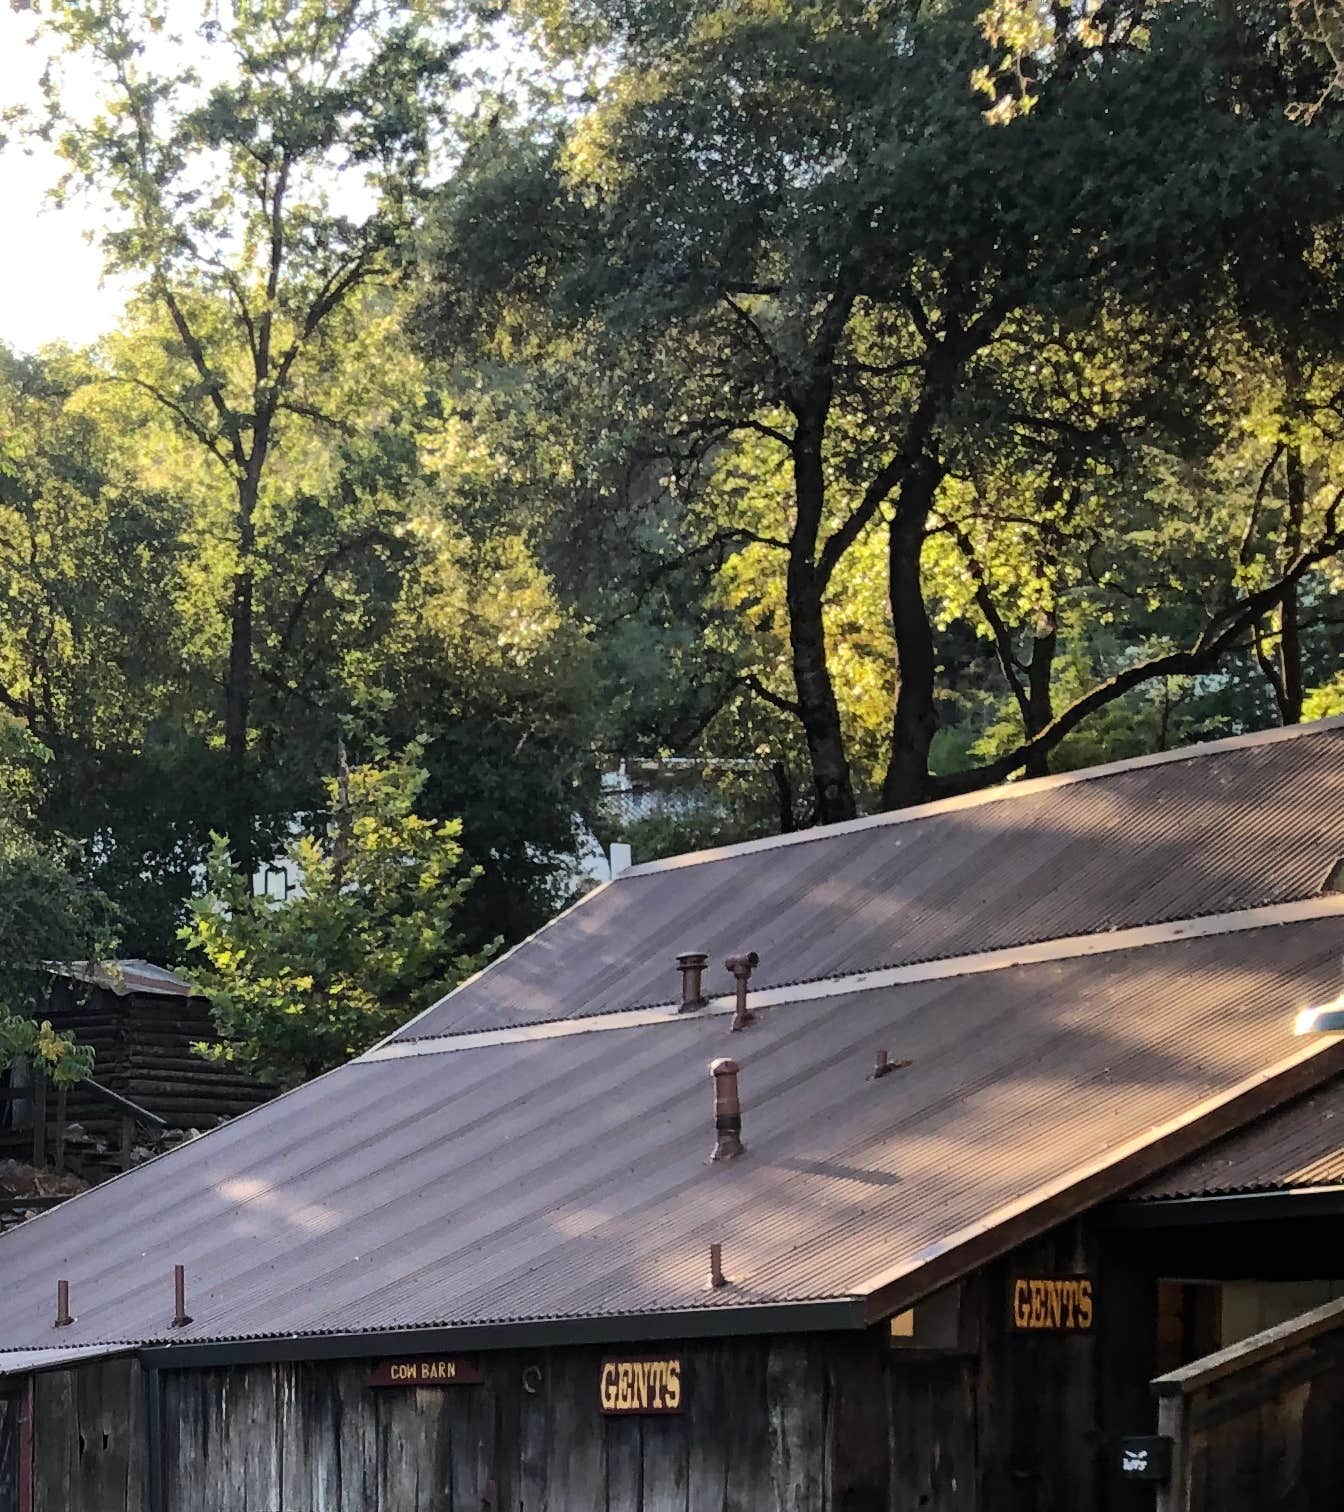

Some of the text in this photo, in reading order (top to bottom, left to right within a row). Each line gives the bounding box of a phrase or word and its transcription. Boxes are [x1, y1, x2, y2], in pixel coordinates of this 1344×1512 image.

[1014, 1279, 1093, 1328] GENTS
[391, 1361, 456, 1380] COW BARN
[600, 1360, 680, 1409] GENTS
